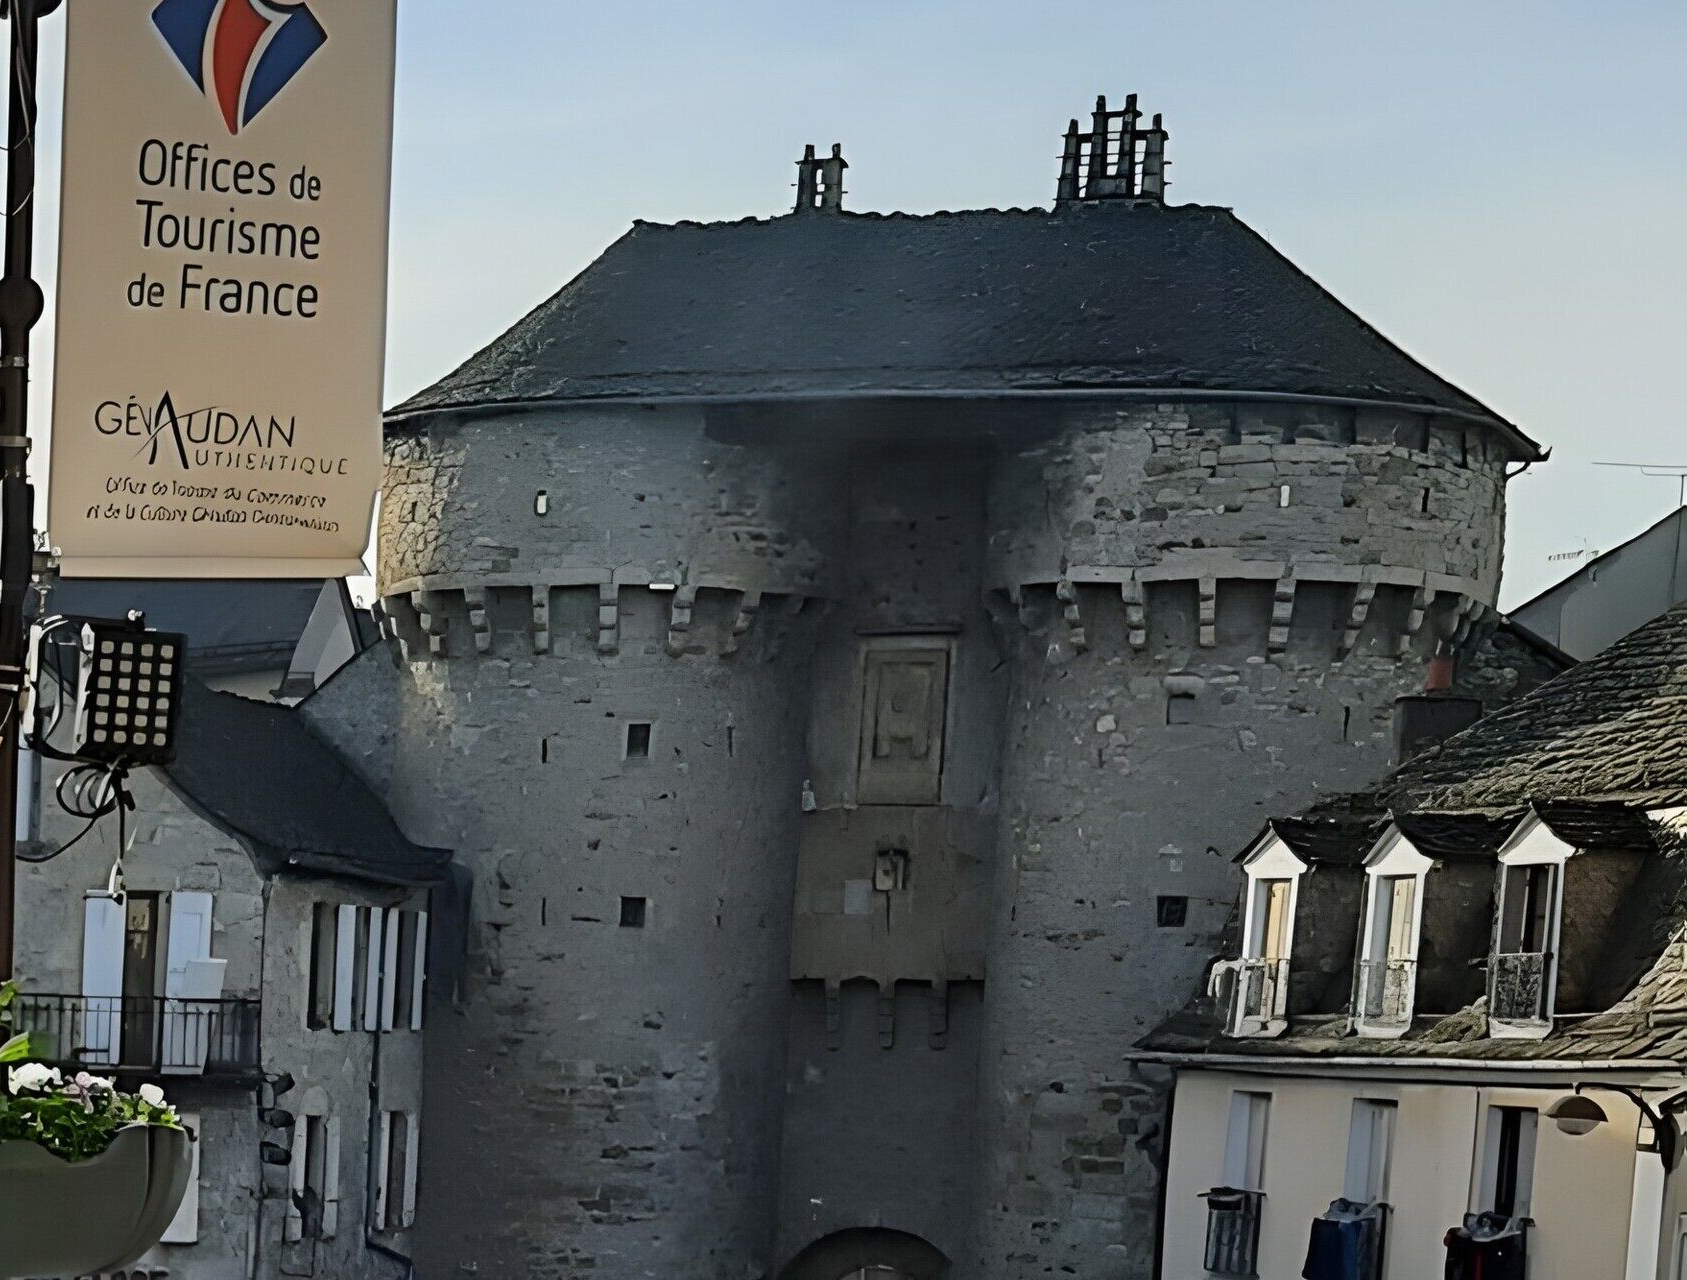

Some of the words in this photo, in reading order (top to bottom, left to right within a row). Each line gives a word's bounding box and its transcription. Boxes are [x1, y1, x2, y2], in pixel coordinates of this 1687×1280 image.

[139, 138, 276, 196] Offices
[289, 165, 322, 201] de
[136, 199, 320, 260] Tourisme
[127, 272, 165, 307] de
[180, 263, 319, 318] France
[94, 390, 295, 469] GÉVAUDAN
